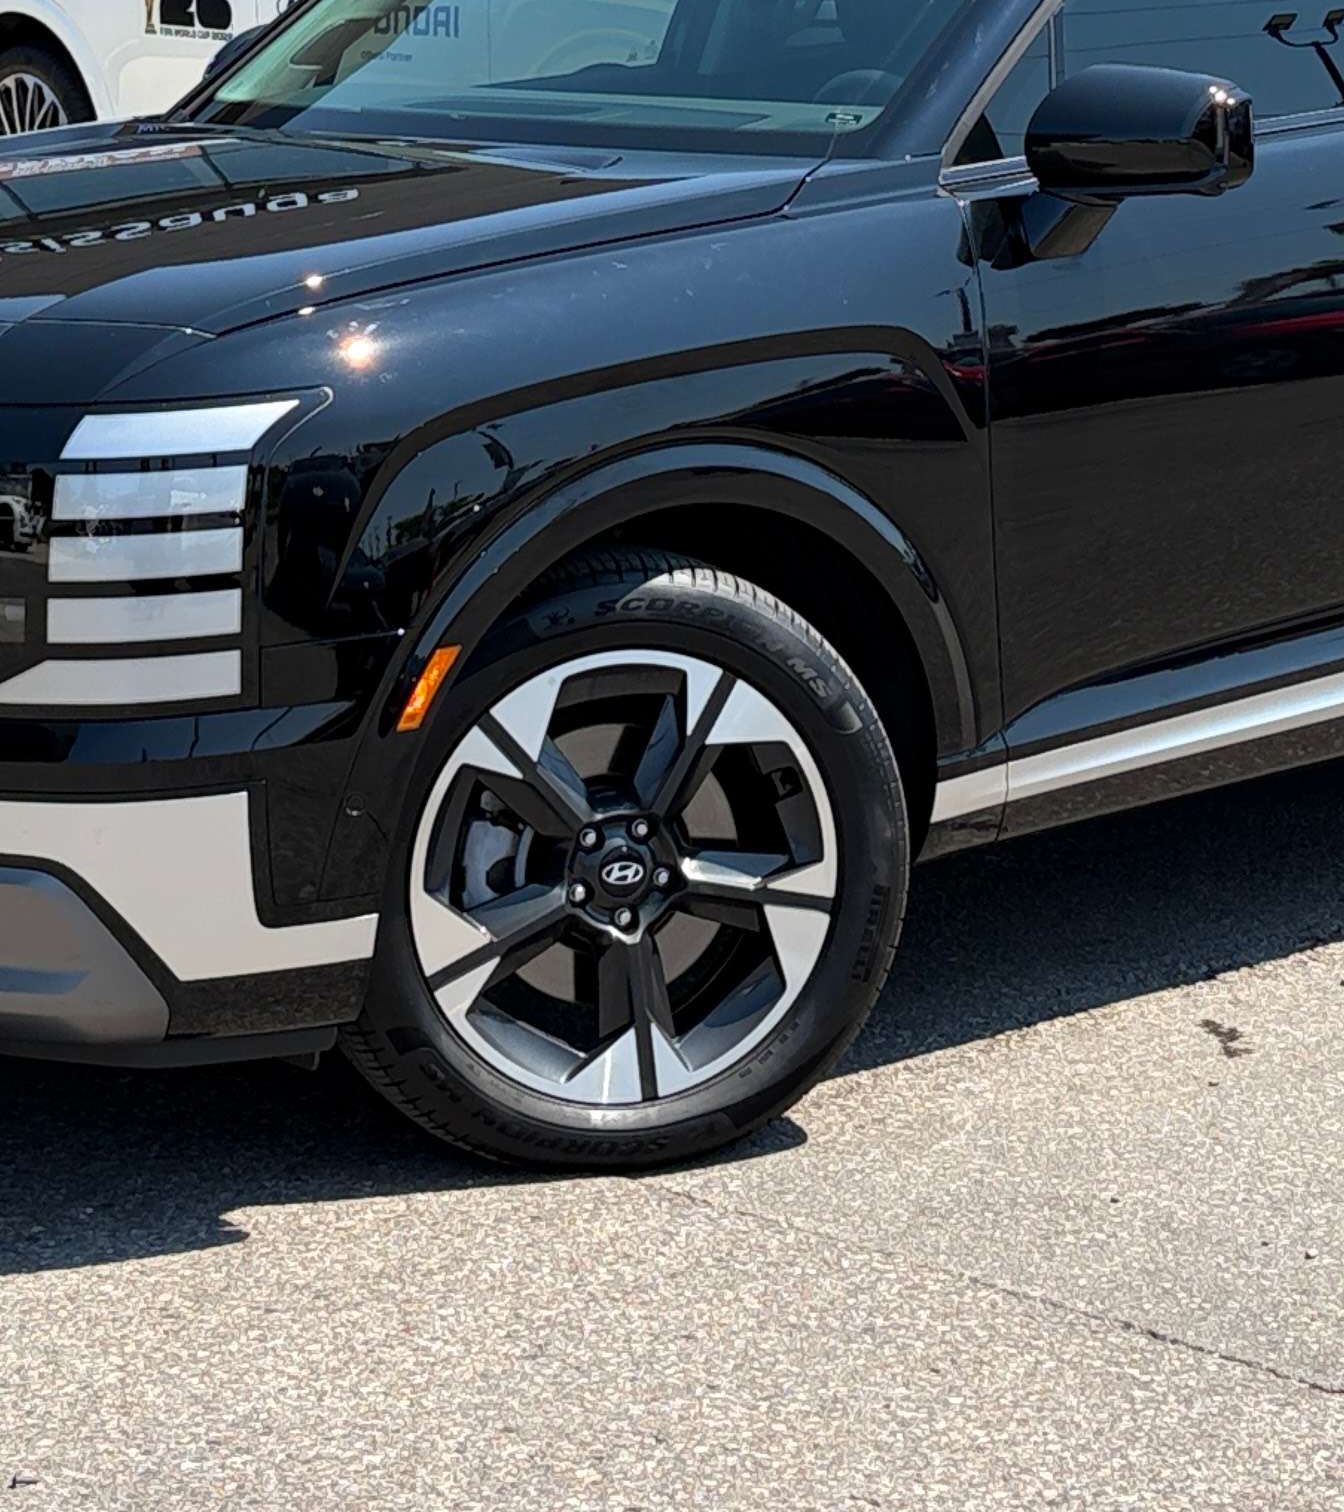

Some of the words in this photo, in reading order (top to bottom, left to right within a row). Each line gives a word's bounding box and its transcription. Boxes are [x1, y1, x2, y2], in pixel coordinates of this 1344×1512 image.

[374, 5, 459, 38] UNDAI
[593, 595, 785, 655] SCORPION
[786, 655, 833, 700] MS
